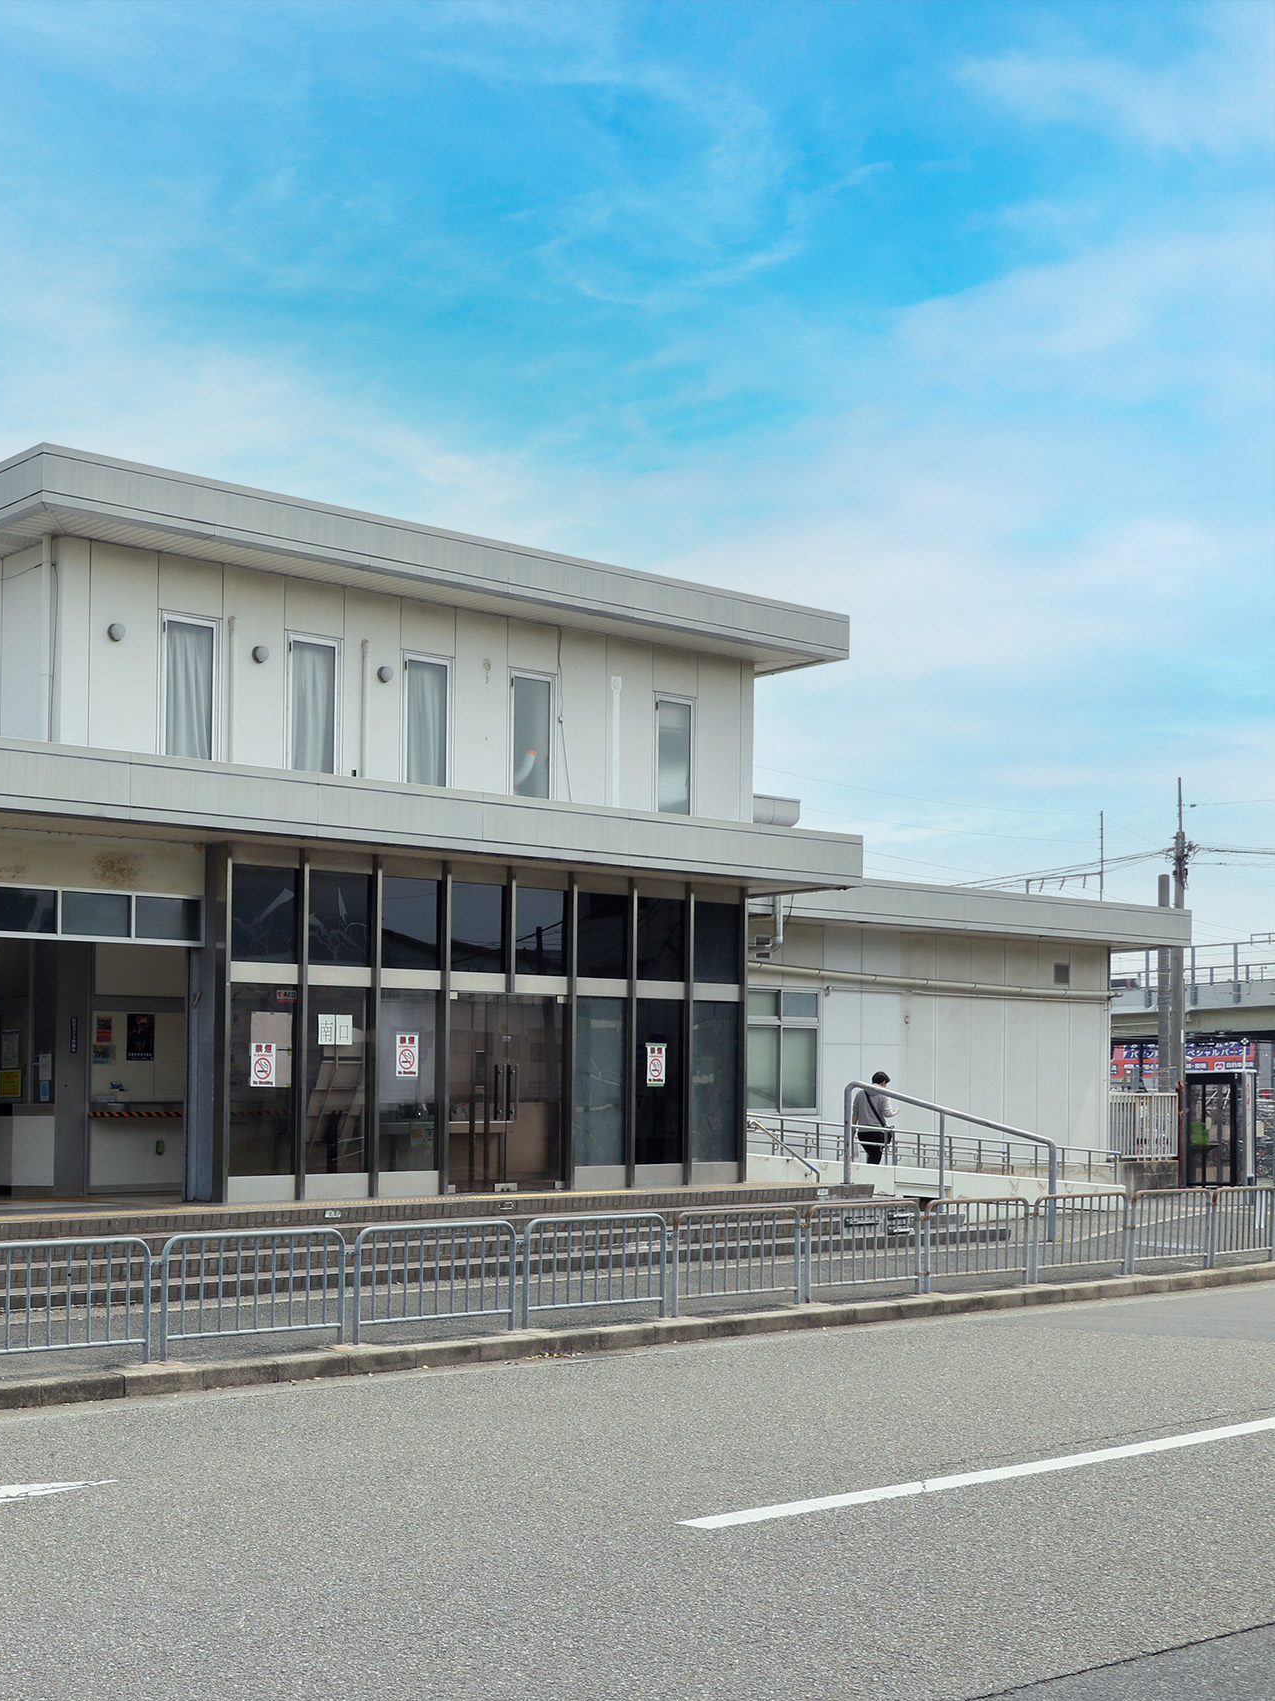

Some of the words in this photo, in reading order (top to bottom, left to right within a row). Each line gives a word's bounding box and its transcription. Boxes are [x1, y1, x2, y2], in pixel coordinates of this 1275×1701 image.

[320, 1020, 349, 1042] 南口
[400, 1036, 415, 1045] 禁煙
[255, 1044, 273, 1053] 禁煙
